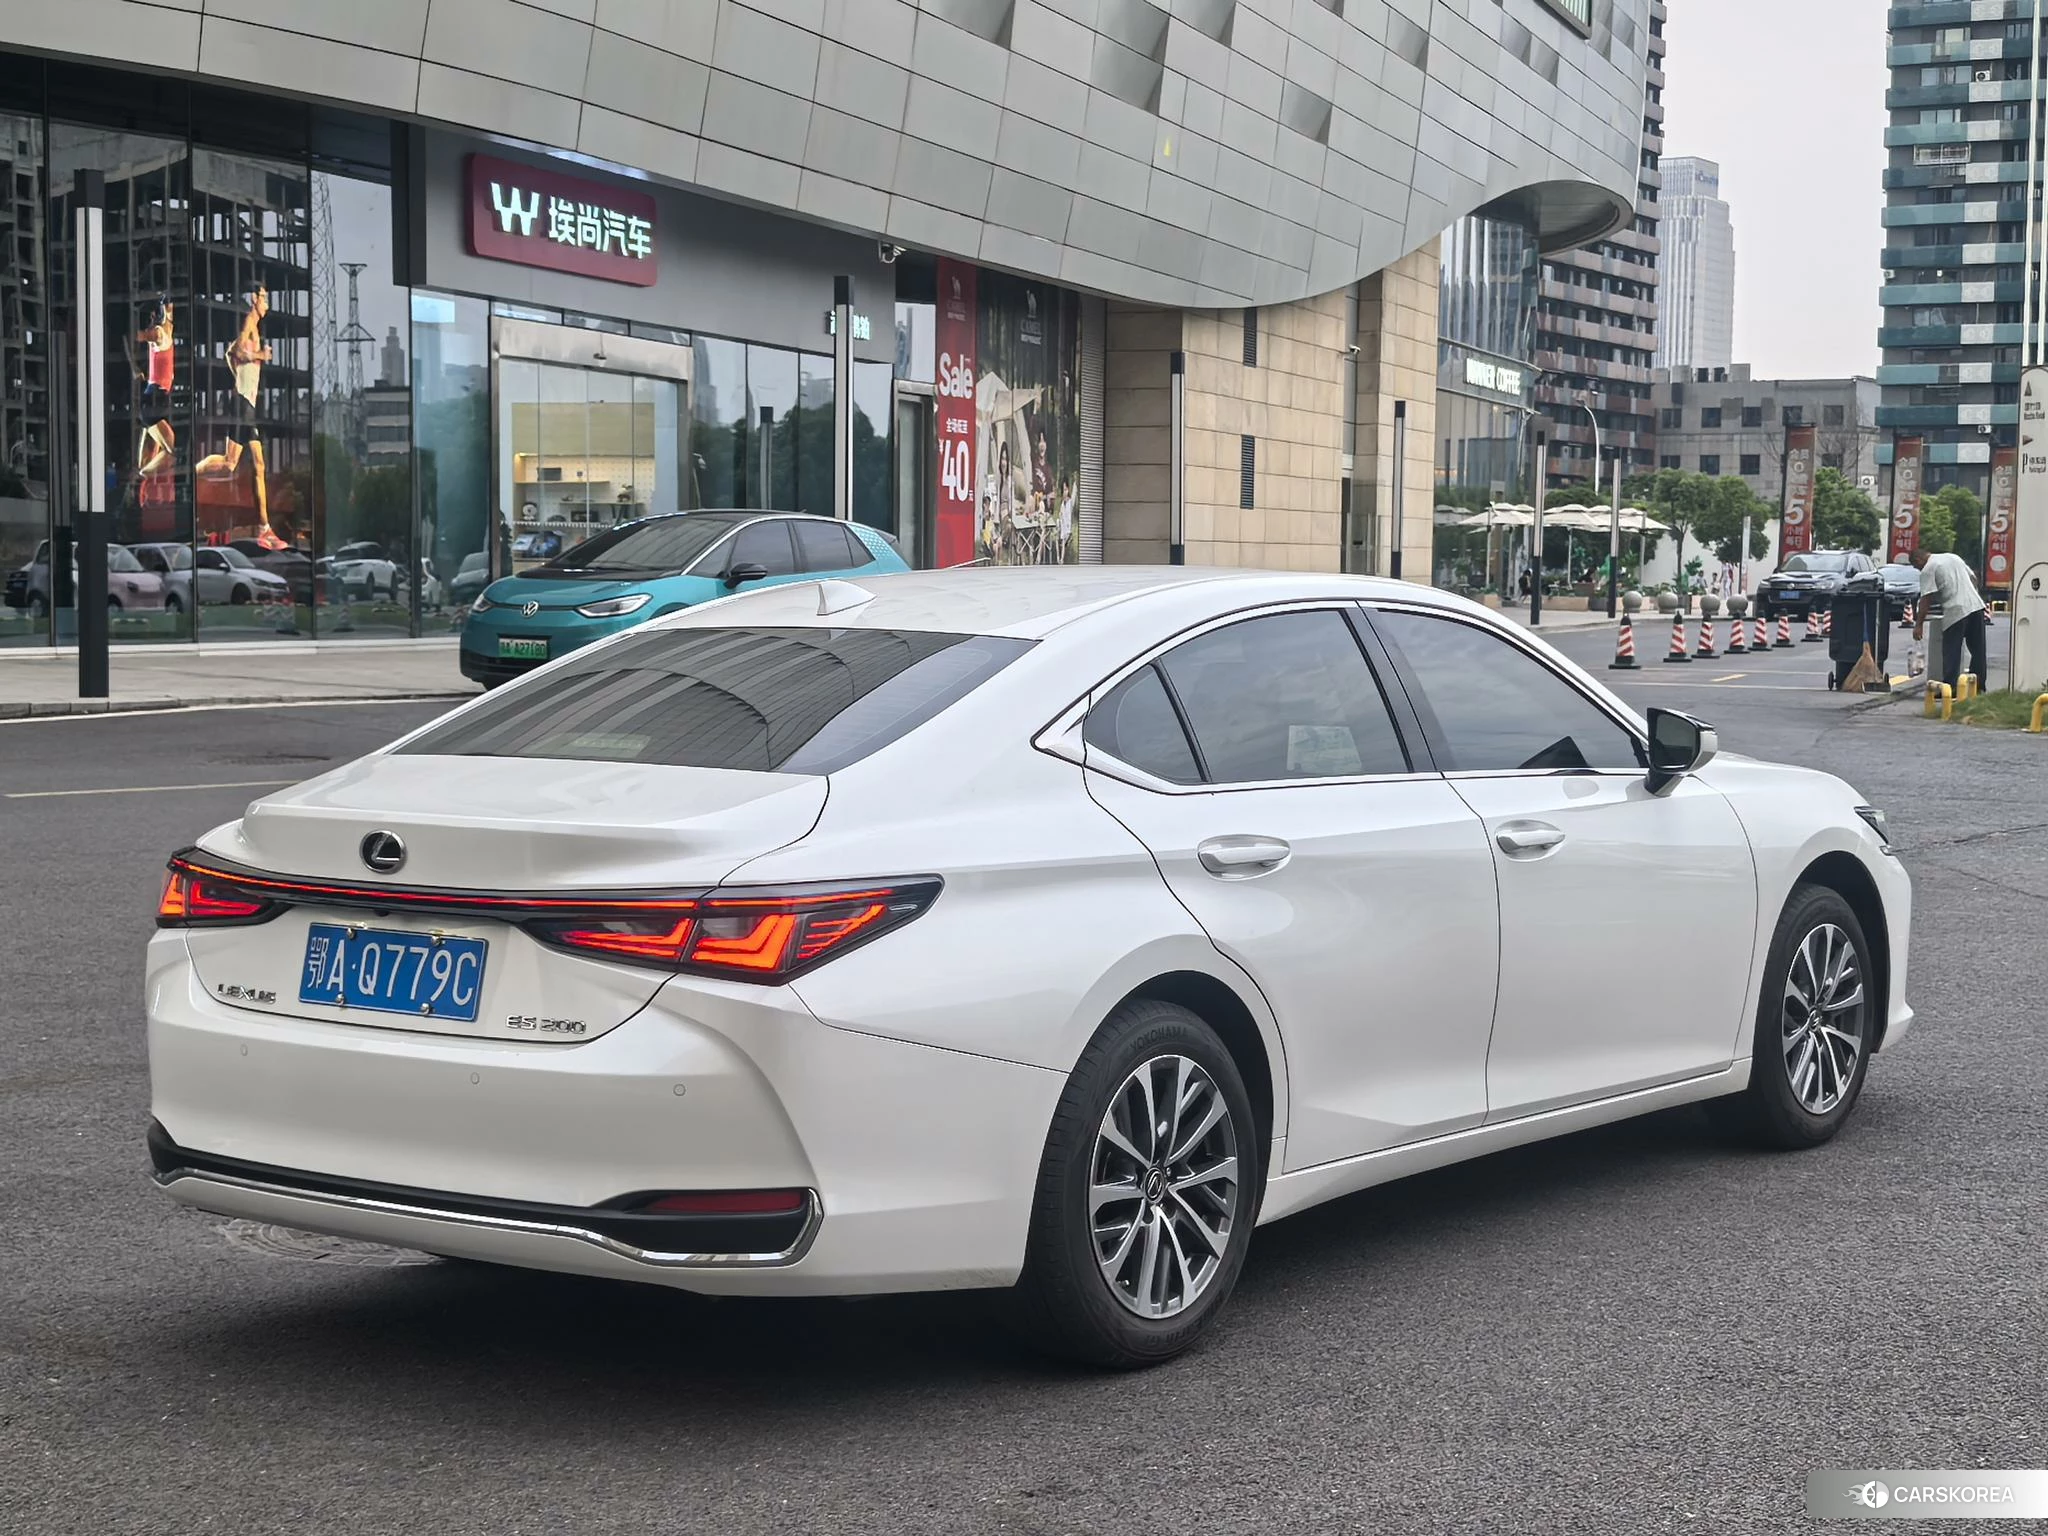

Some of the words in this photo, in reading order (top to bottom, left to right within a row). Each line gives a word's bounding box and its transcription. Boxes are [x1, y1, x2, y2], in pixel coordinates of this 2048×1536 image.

[548, 196, 652, 259] 埃尚汽车
[940, 352, 973, 399] Sale
[1496, 367, 1521, 396] COFFEE
[1784, 499, 1805, 525] 5
[1893, 503, 1914, 529] 5
[1991, 509, 2009, 533] 5
[506, 1015, 537, 1031] ES
[540, 1018, 586, 1034] 200
